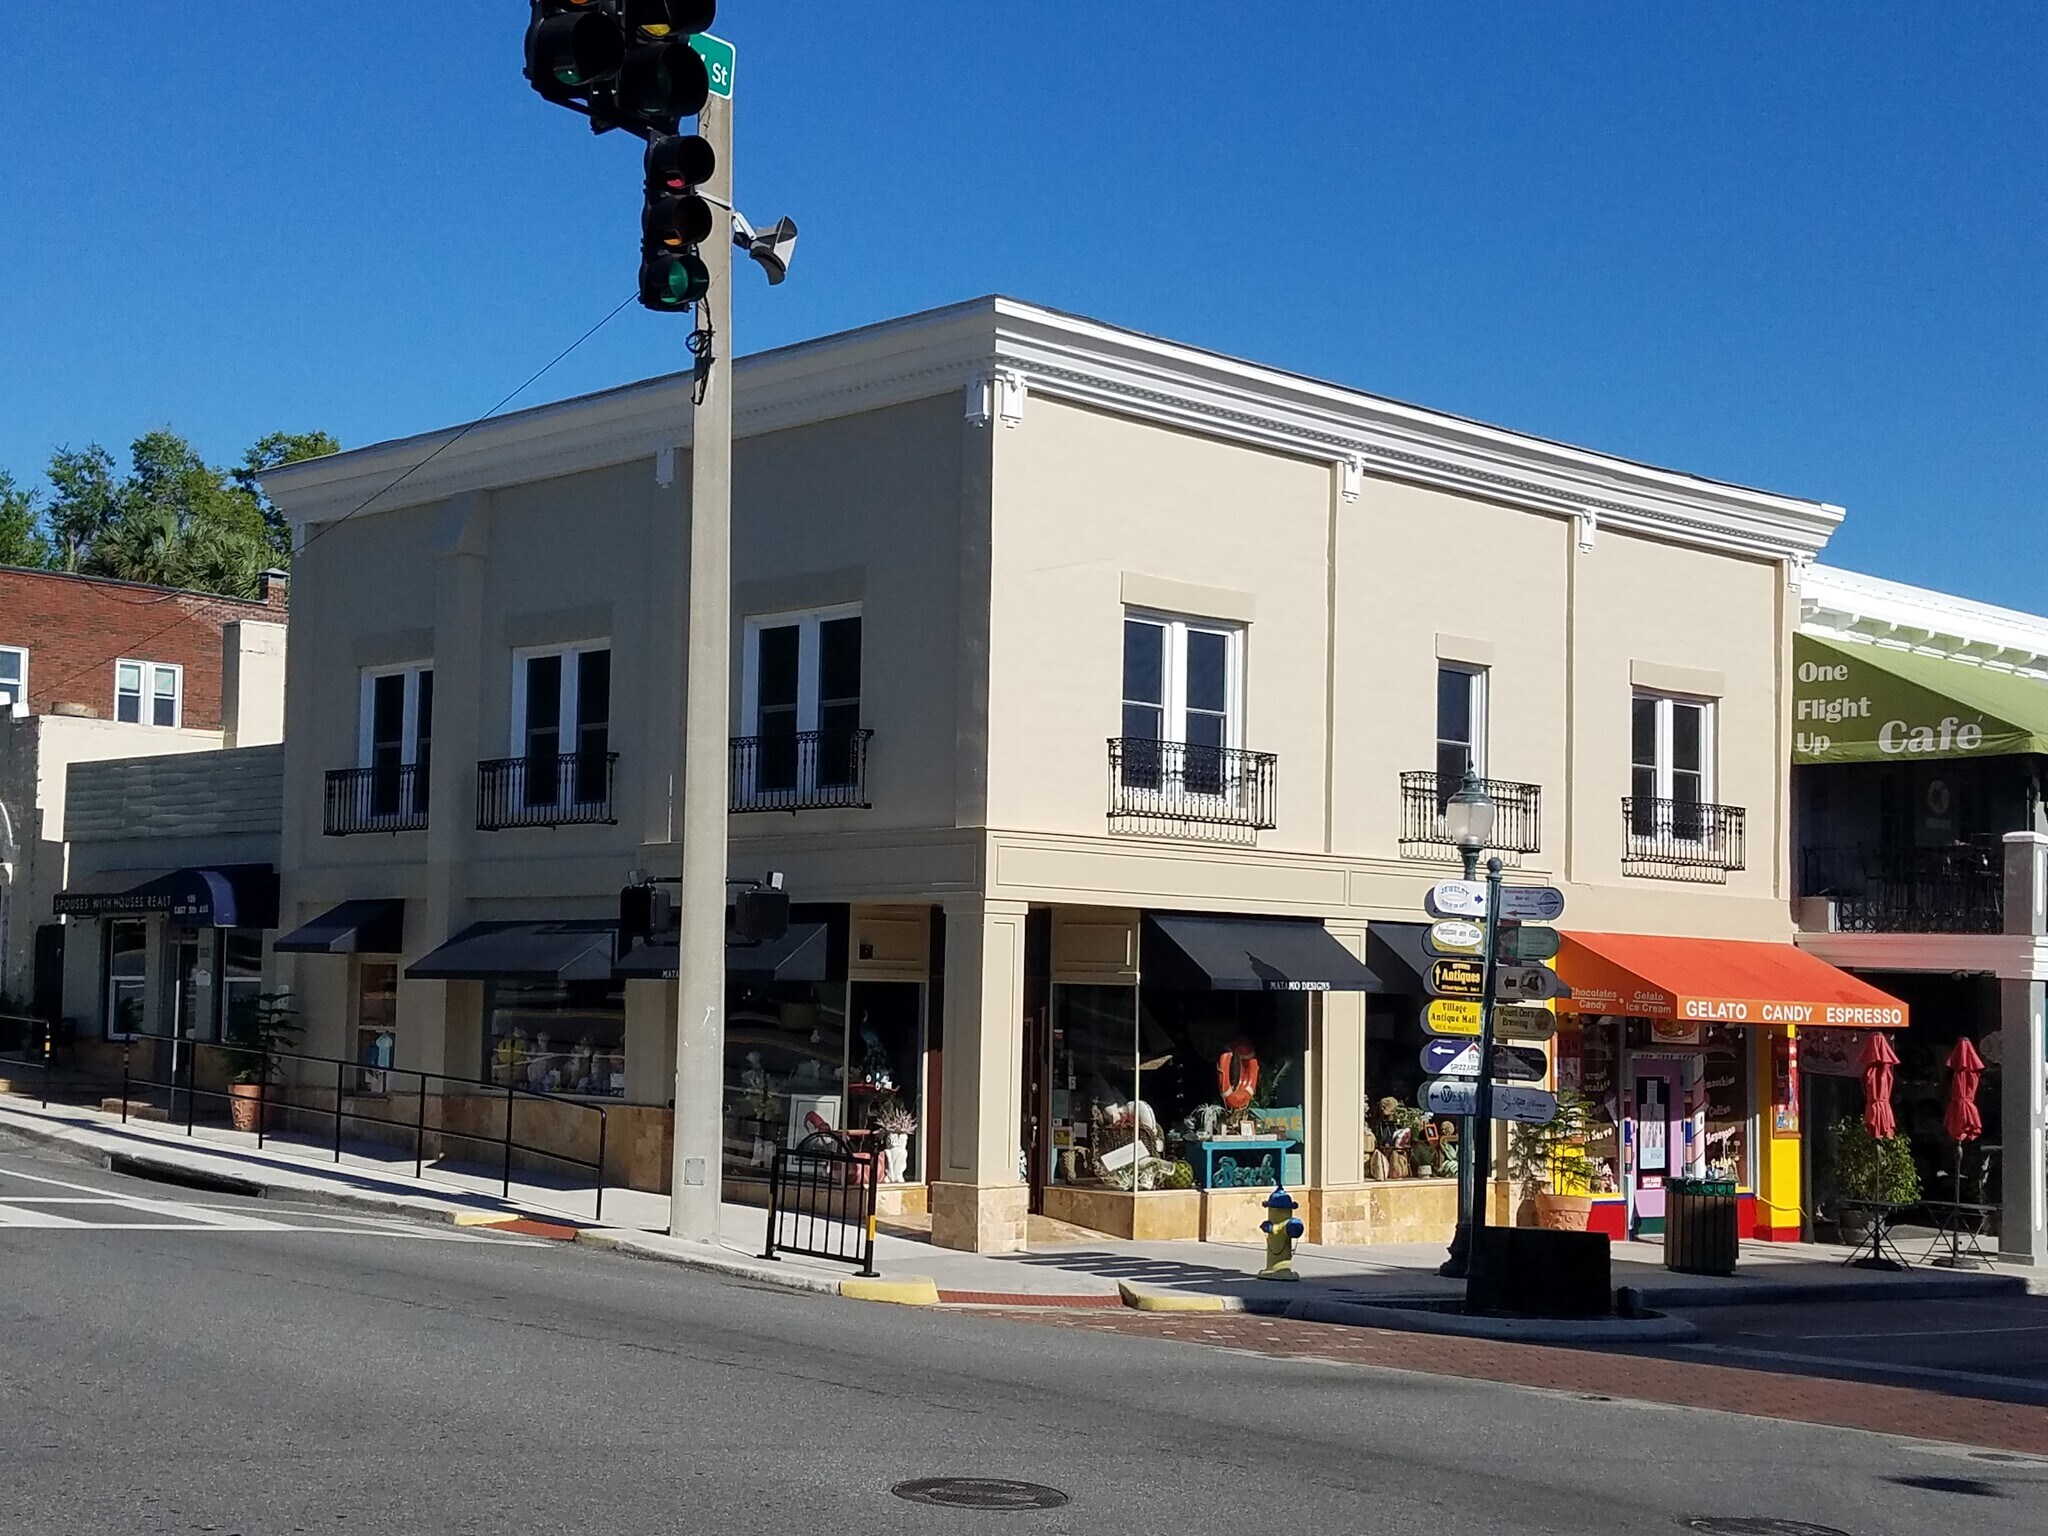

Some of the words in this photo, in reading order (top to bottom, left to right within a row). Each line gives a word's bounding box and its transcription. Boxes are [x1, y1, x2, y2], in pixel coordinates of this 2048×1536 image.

[711, 62, 728, 87] St
[1798, 661, 1849, 683] One
[1796, 696, 1872, 723] Flight
[1878, 714, 1984, 754] Café
[1796, 731, 1831, 755] Up
[55, 897, 88, 911] SPOUSES
[92, 898, 112, 910] WITH
[113, 896, 144, 909] HOUSES
[147, 895, 172, 908] REALT
[661, 969, 679, 979] MATA
[1441, 967, 1481, 985] Antiques
[1301, 981, 1331, 991] DESIGNS
[1633, 990, 1664, 1001] Gelato
[1442, 1002, 1468, 1014] Village
[1498, 1007, 1518, 1017] Mount
[1579, 999, 1607, 1012] Candy
[1625, 1001, 1640, 1012] Ice
[1641, 1003, 1672, 1014] Cream
[1431, 1012, 1460, 1024] Antique
[1461, 1014, 1478, 1024] Mall
[1686, 1000, 1748, 1020] GELATO
[1762, 1003, 1813, 1023] CANDY
[1826, 1006, 1902, 1025] ESPRESSO
[1502, 1017, 1529, 1029] Brewing
